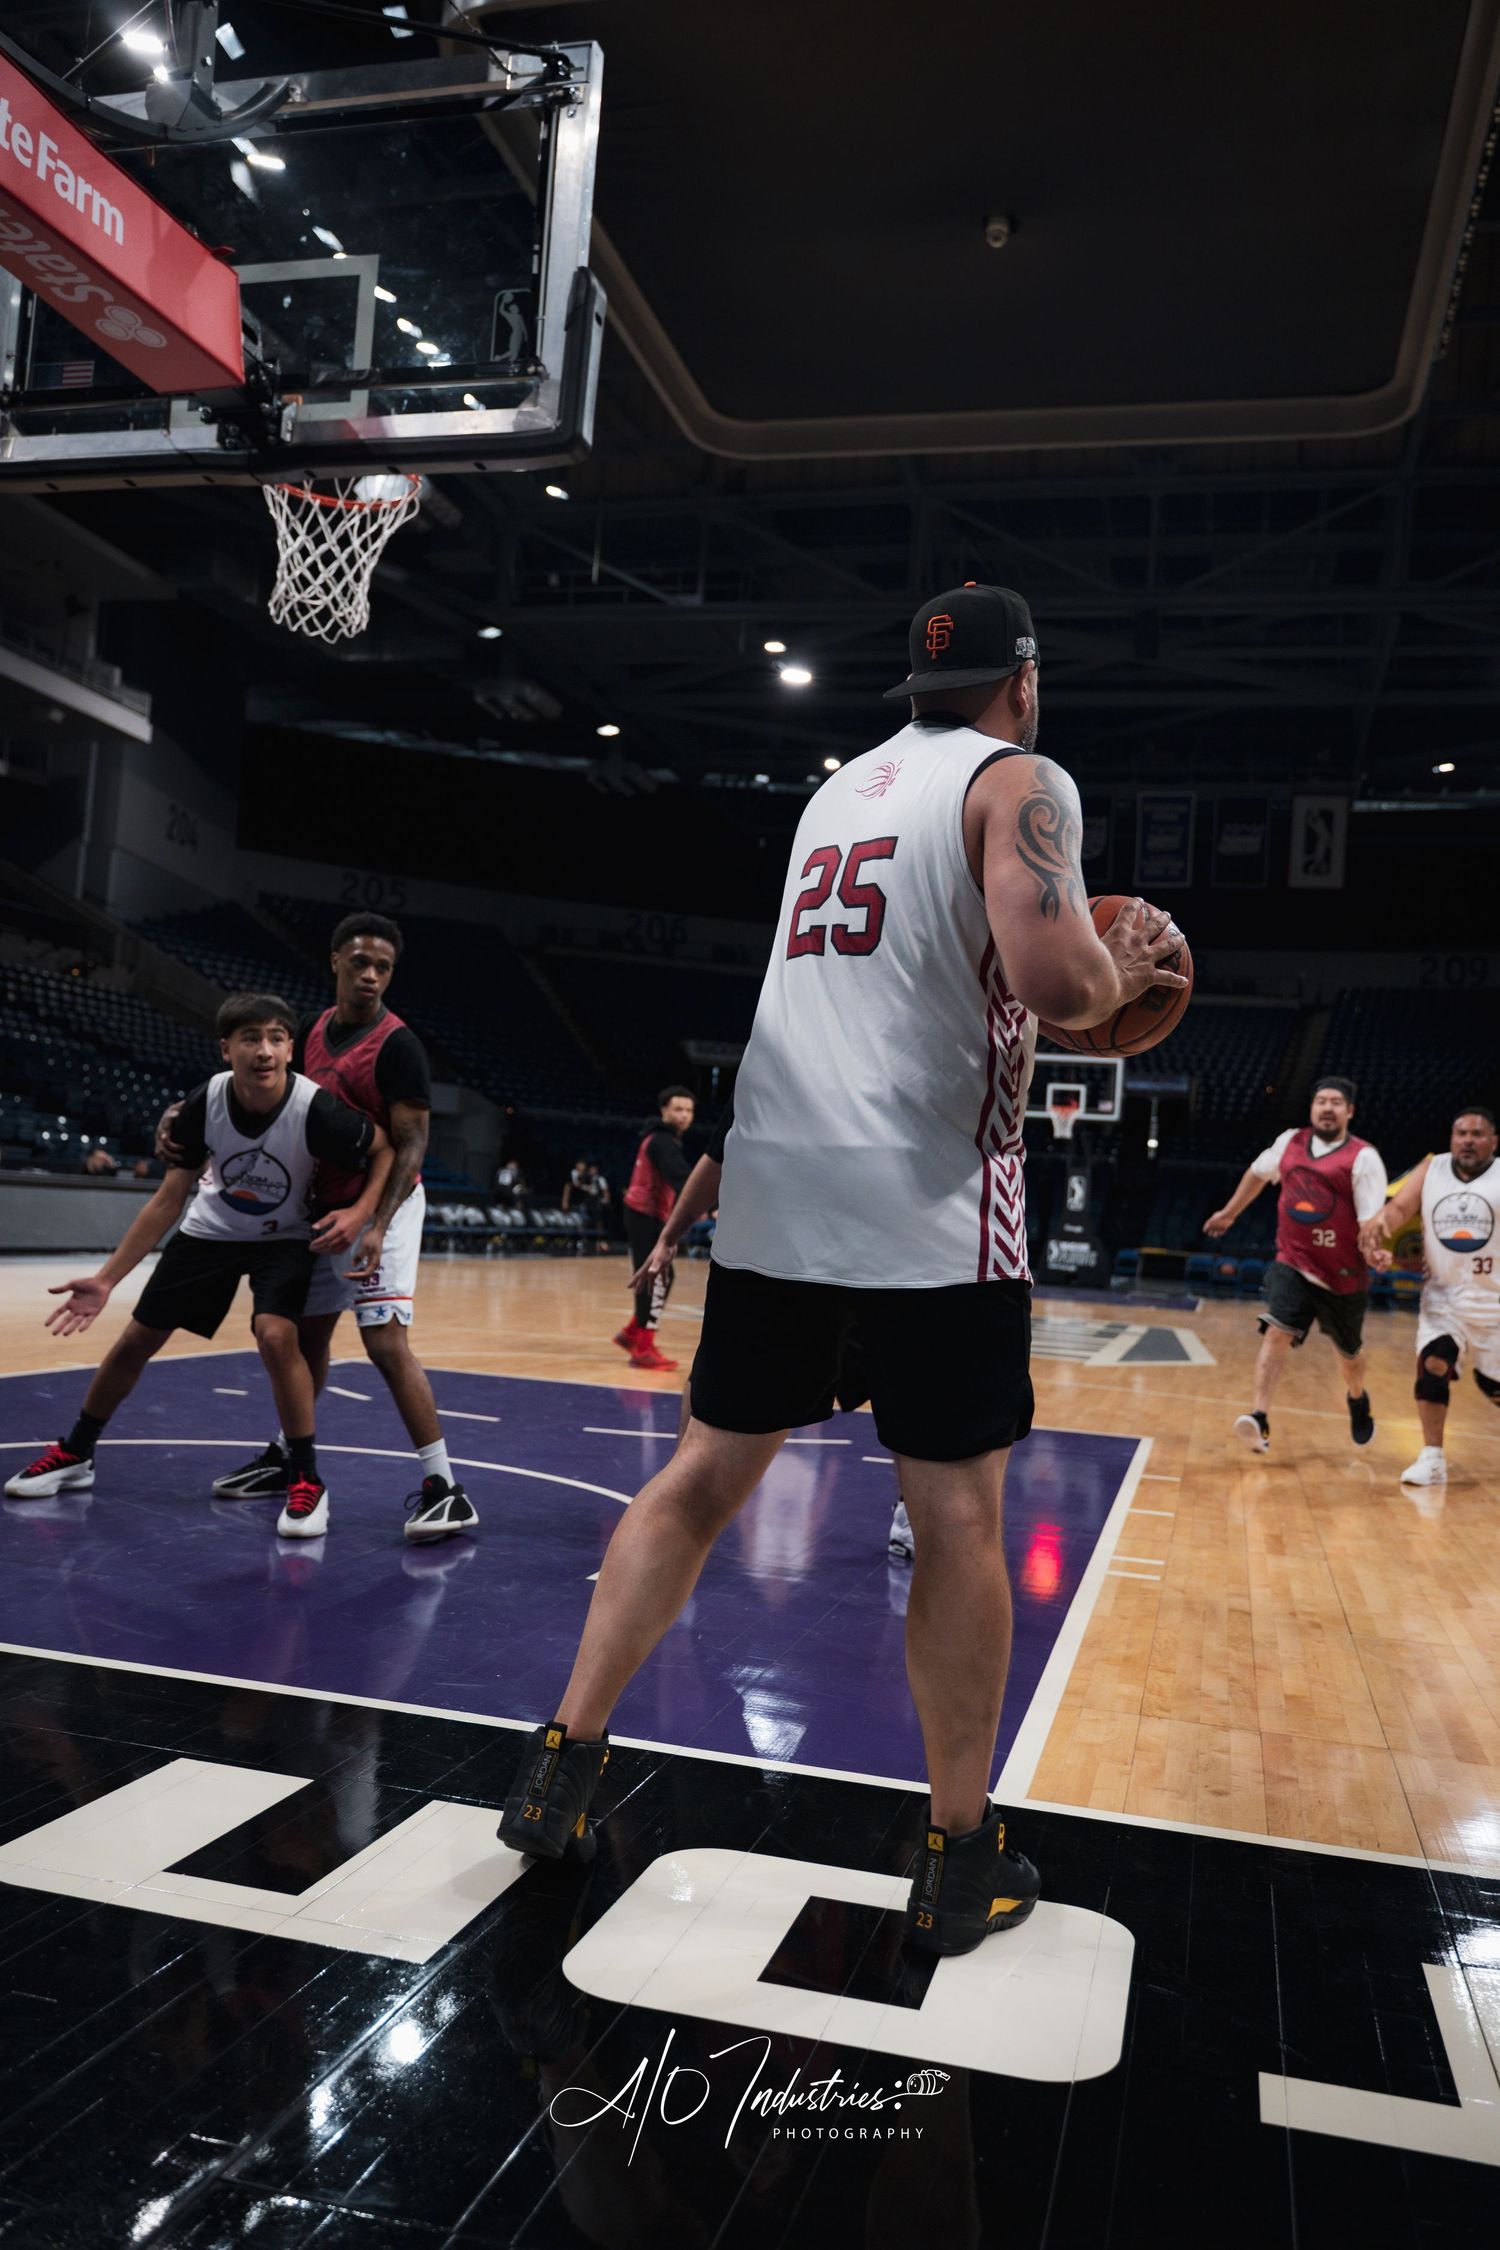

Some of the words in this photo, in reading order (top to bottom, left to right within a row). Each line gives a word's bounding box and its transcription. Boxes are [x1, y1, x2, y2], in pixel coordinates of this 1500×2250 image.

[926, 614, 954, 660] SF
[341, 871, 406, 910] 205
[786, 836, 899, 961] 25
[1420, 955, 1488, 986] 209
[1311, 1228, 1338, 1248] 32
[1472, 1257, 1493, 1274] 33
[534, 1754, 553, 1790] JORDAN
[522, 1804, 542, 1821] 23
[924, 1857, 938, 1897] JORDAN
[916, 1911, 934, 1929] 23
